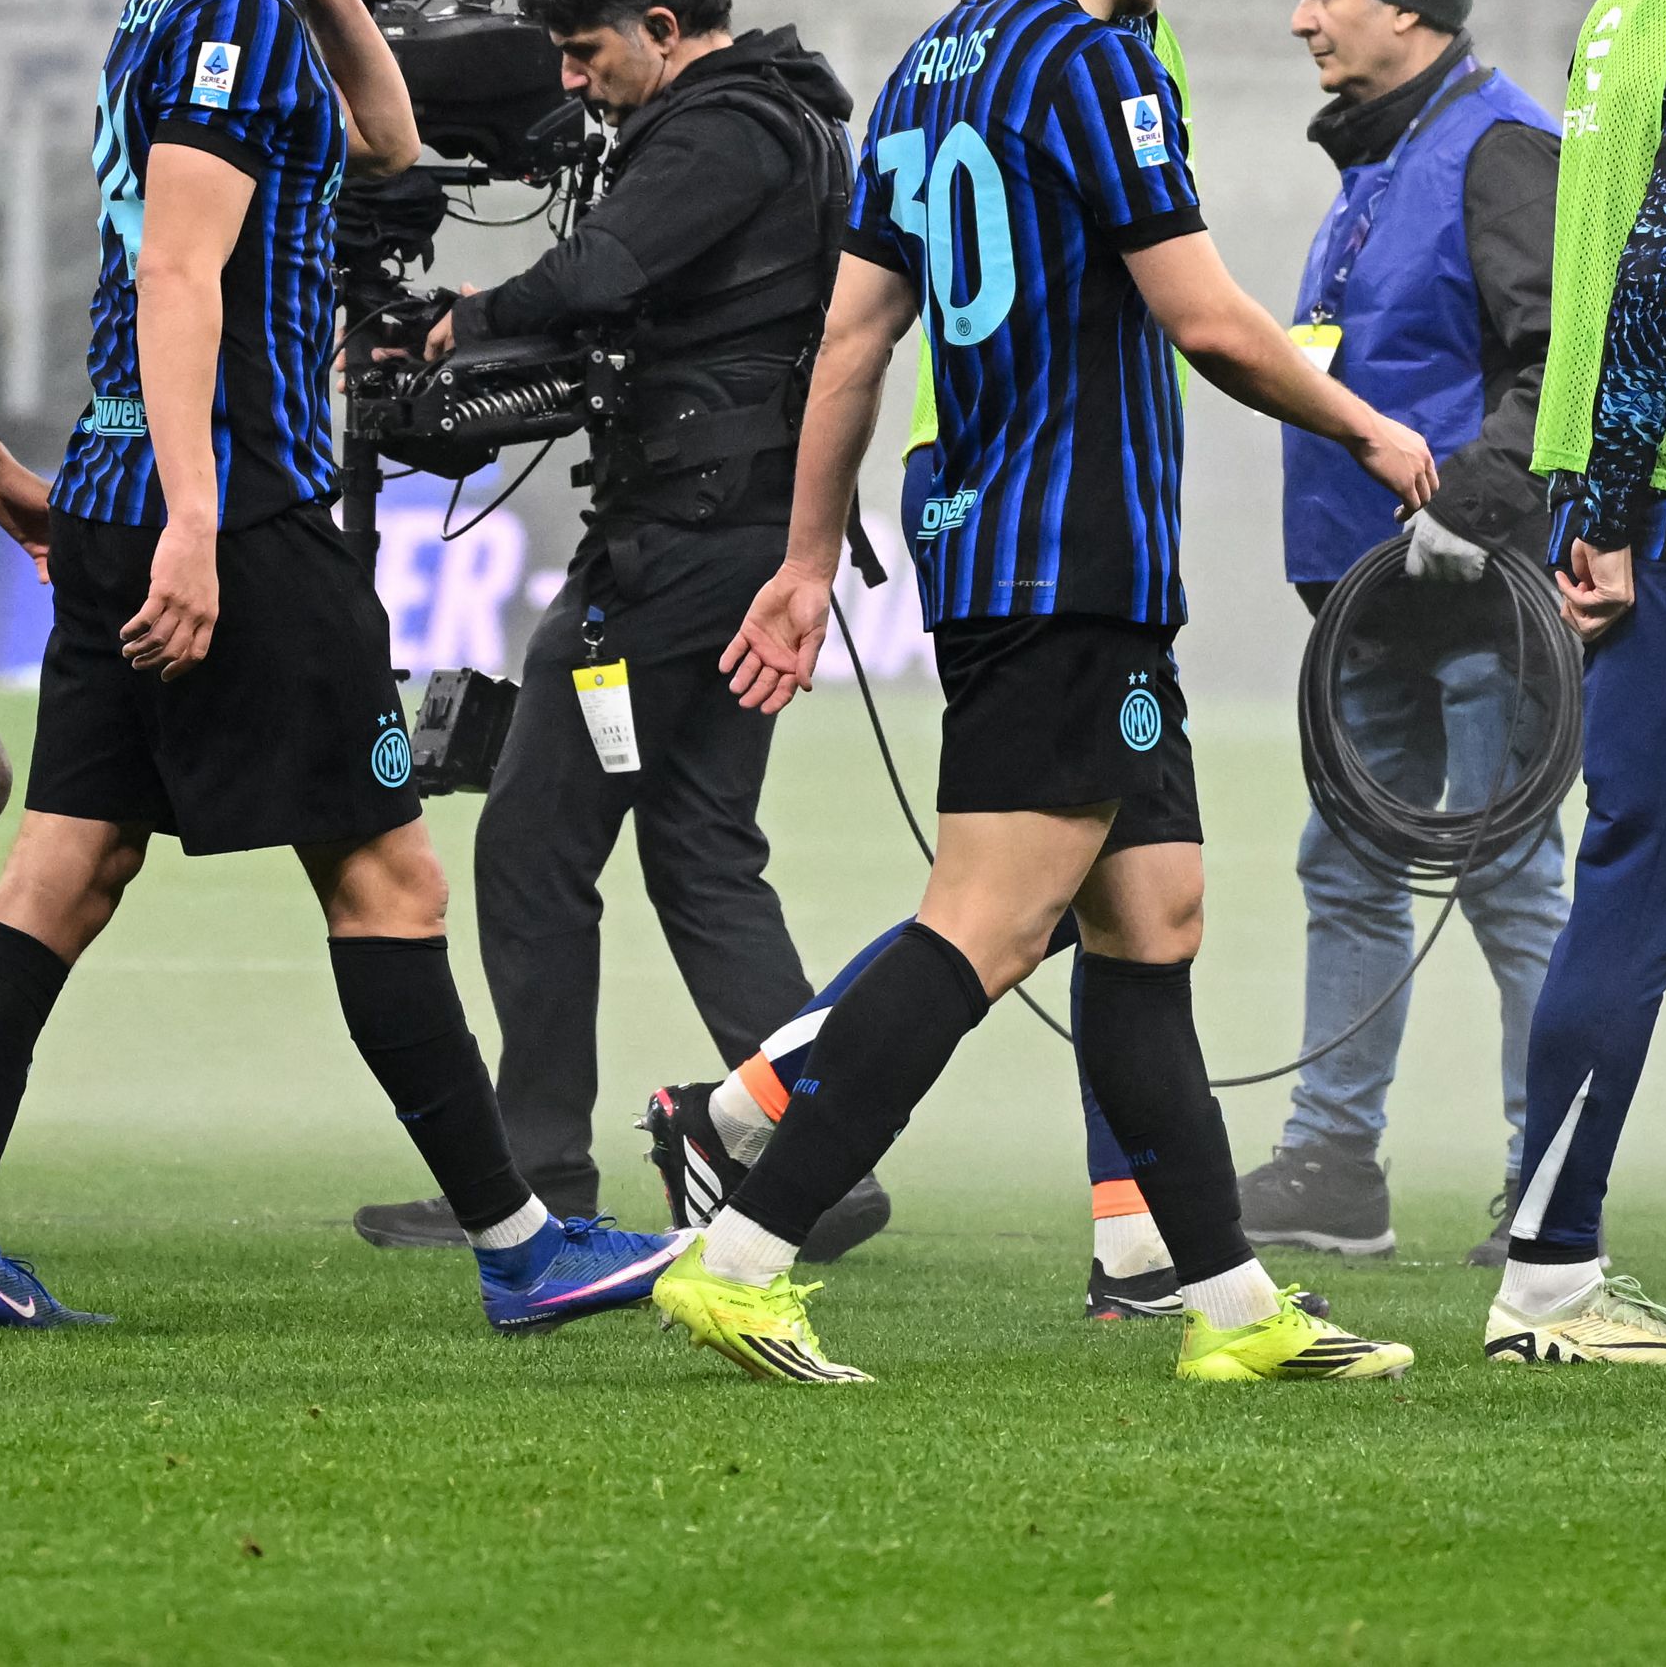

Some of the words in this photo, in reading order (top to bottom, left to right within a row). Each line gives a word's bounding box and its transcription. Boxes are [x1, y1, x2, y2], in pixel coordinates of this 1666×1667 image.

[903, 27, 997, 88] CARLOS
[200, 75, 220, 84] SERIE
[1136, 133, 1157, 143] SERIE
[877, 121, 1016, 346] 30
